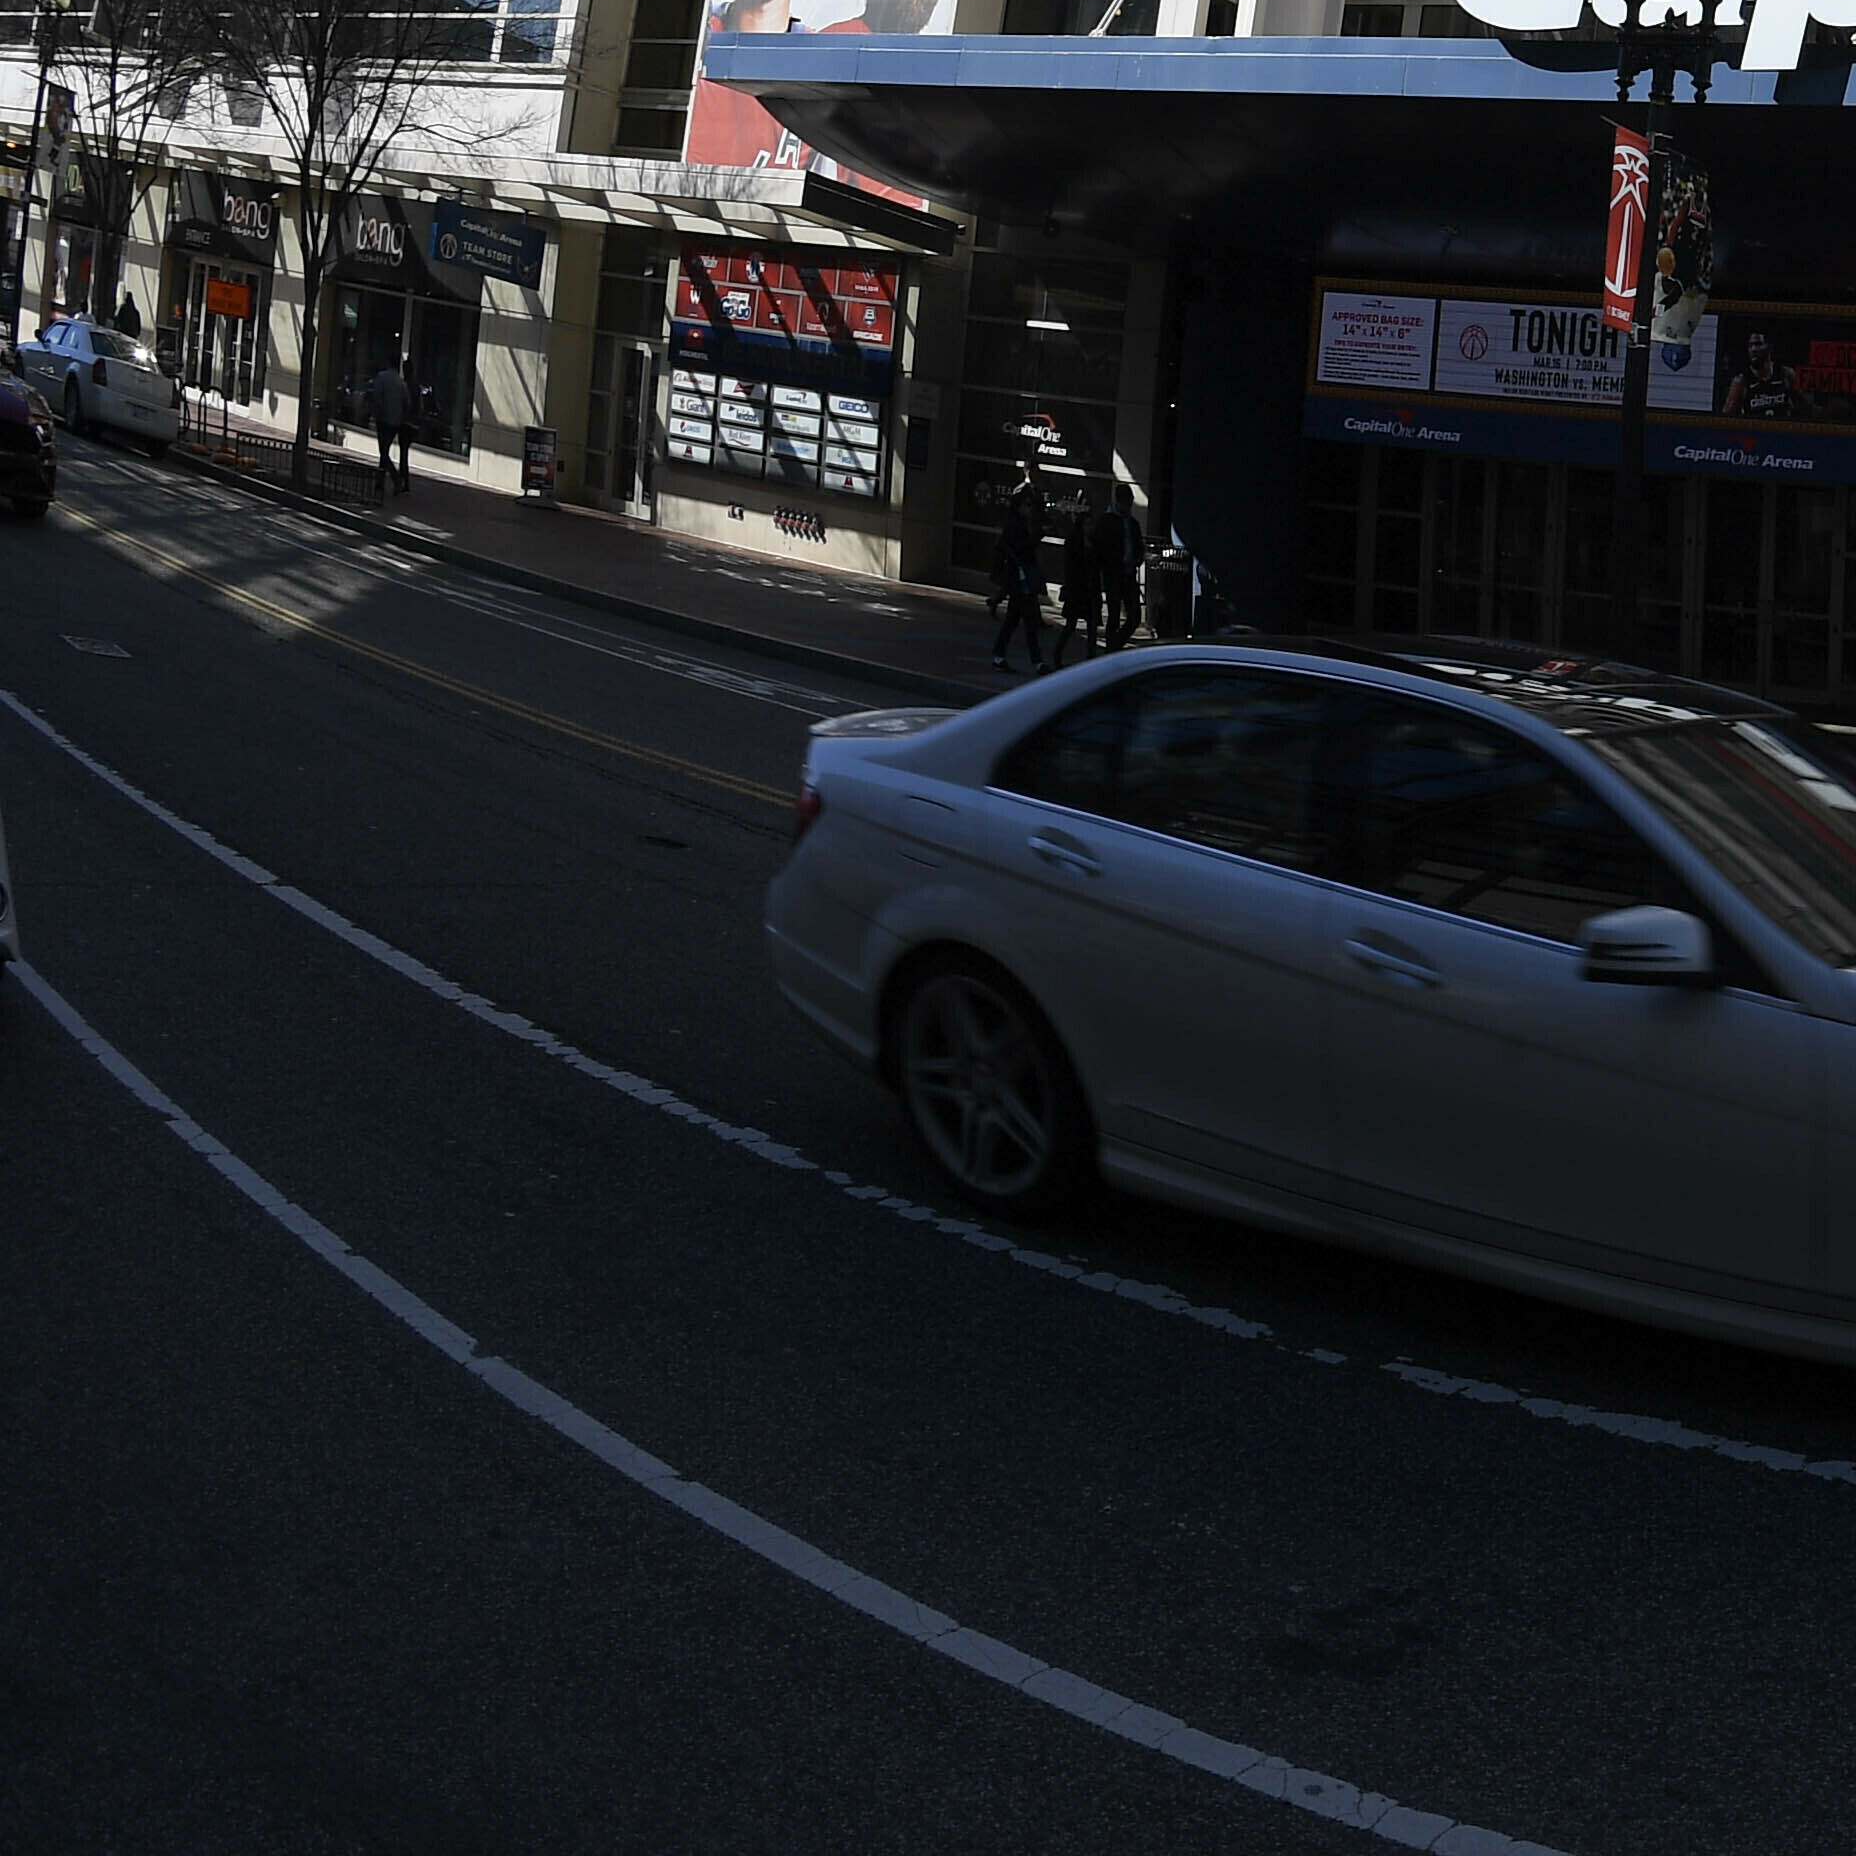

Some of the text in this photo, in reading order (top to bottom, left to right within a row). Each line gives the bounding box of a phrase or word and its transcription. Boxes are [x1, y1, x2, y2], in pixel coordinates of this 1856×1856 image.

[224, 188, 272, 240] bang
[357, 214, 406, 267] bang
[463, 241, 486, 256] TEAM
[487, 248, 513, 265] STORE
[1331, 311, 1379, 325] APPROVED
[1380, 315, 1400, 326] BAG
[1343, 324, 1361, 336] 14"
[1370, 326, 1388, 338] 14"
[1510, 309, 1618, 358] TONIGH
[1494, 367, 1569, 389] WASHINGTON
[1592, 375, 1625, 394] MEMP
[1417, 426, 1461, 443] Arena
[1037, 443, 1067, 457] Arena
[1762, 454, 1815, 471] Arena
